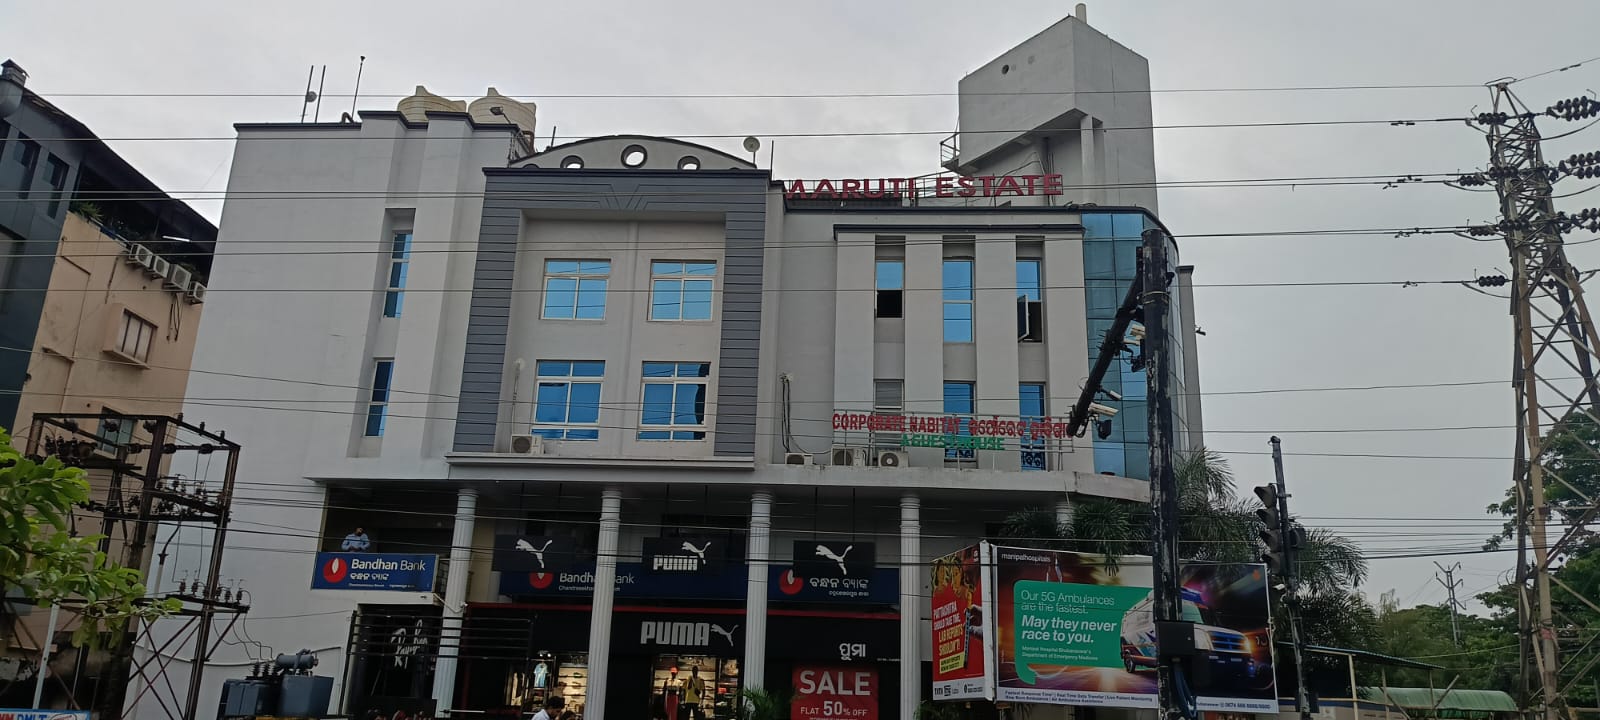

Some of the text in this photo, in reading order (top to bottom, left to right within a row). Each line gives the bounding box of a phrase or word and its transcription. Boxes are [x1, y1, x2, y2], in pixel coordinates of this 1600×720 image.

[784, 174, 1064, 199] MARUTI ESTATE
[832, 413, 961, 435] CORPORATE HABITAT
[351, 558, 427, 571] Bandhan Bank
[653, 554, 699, 571] PUMA
[559, 571, 635, 584] Bandh ank
[1021, 589, 1115, 606] Our 5G Ambulances
[1021, 602, 1089, 614] are the fastest.
[1021, 615, 1118, 632] May they never
[640, 621, 710, 646] PUMA
[1021, 630, 1095, 645] race to you.
[799, 670, 871, 696] SALE
[800, 700, 869, 717] FLAT 50% OFF
